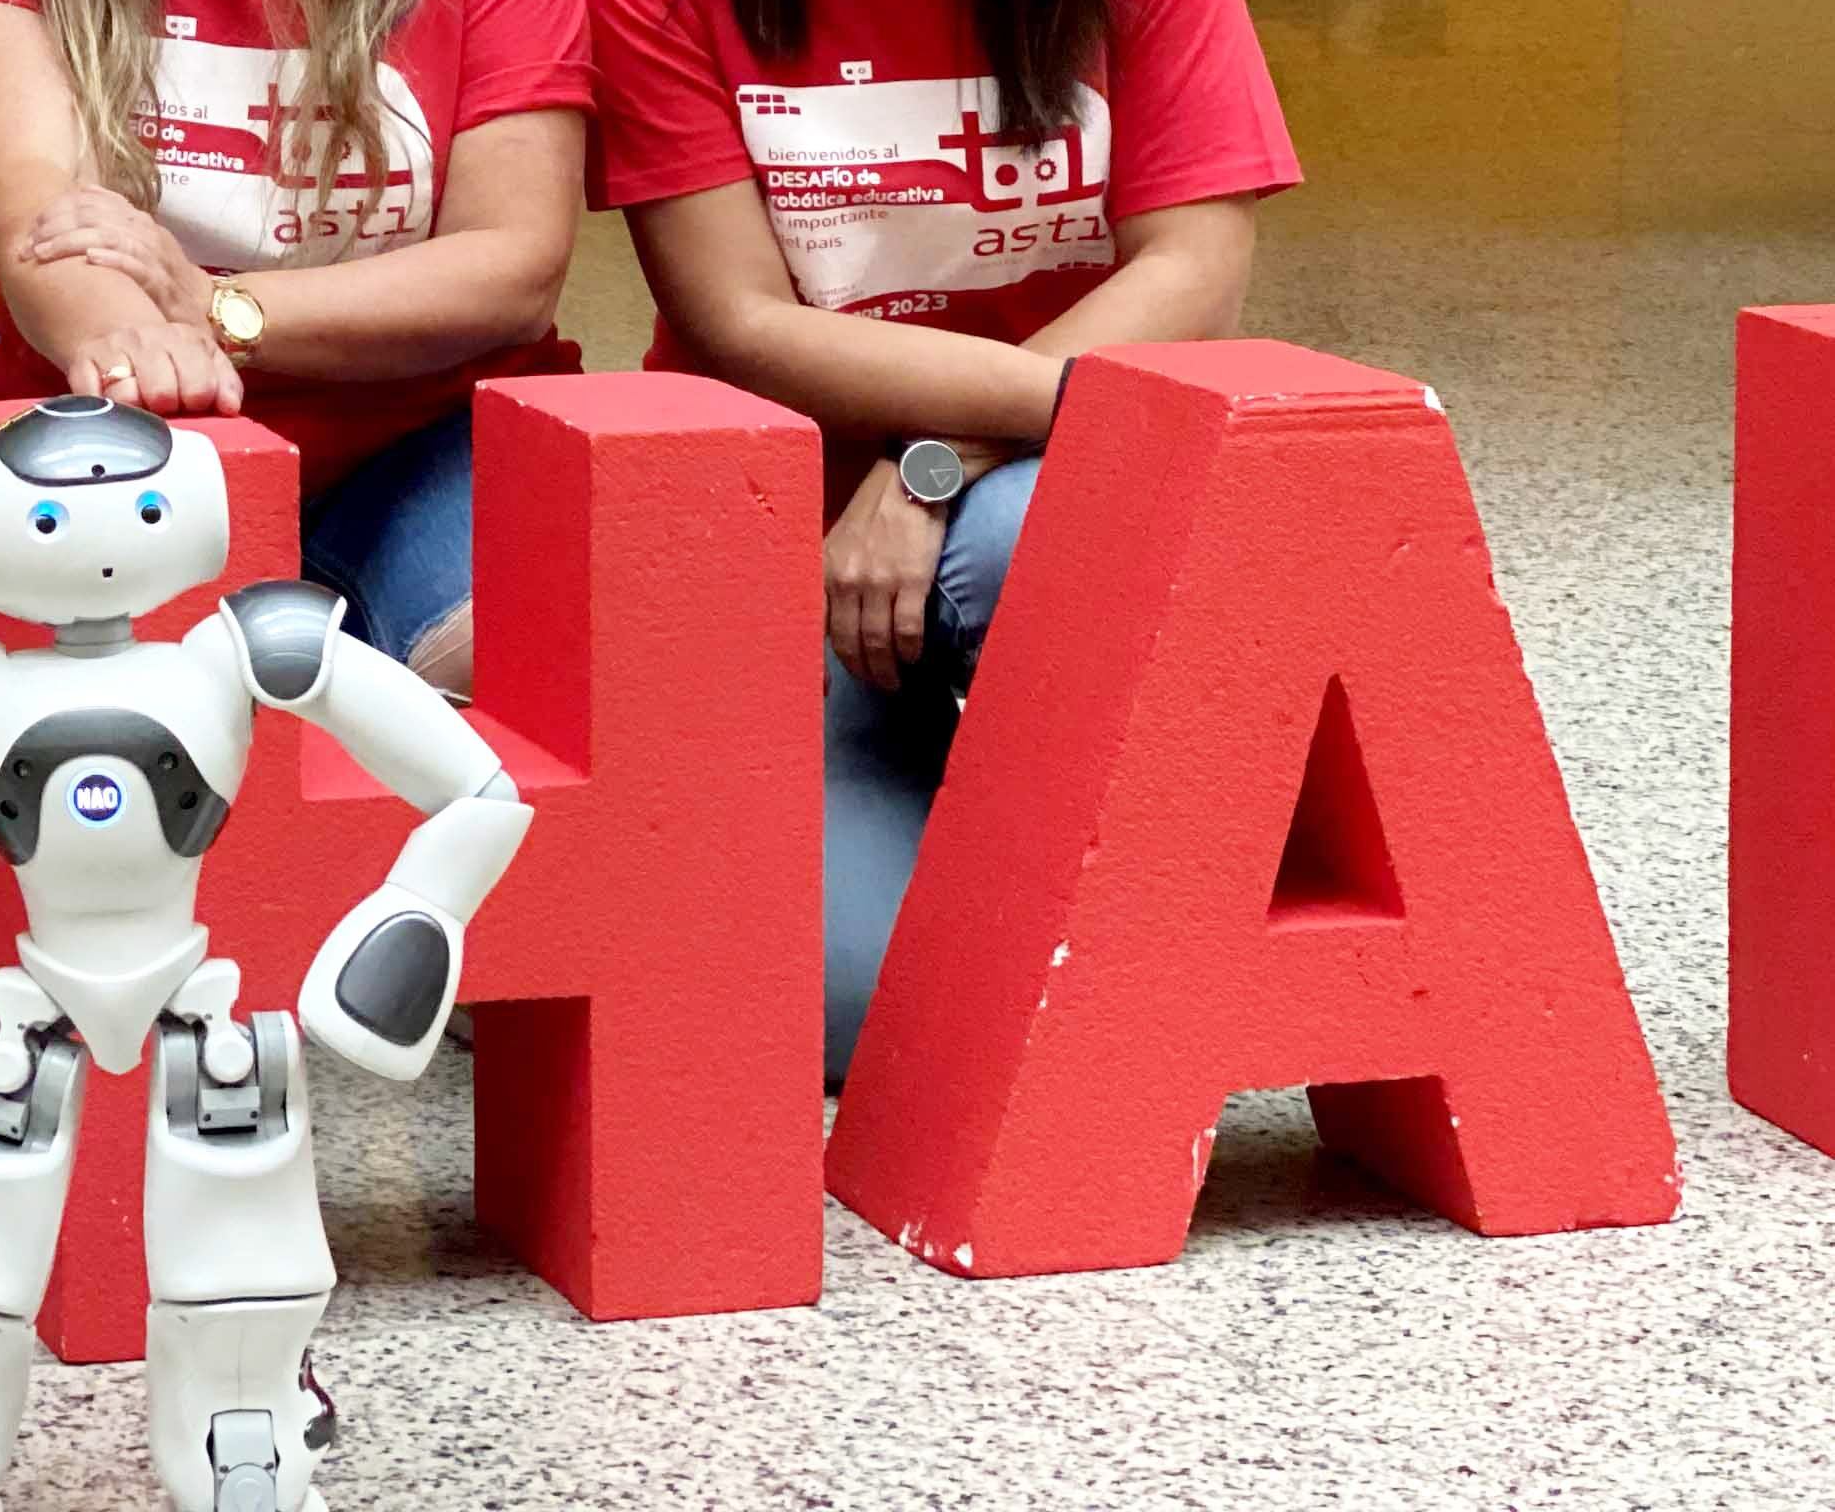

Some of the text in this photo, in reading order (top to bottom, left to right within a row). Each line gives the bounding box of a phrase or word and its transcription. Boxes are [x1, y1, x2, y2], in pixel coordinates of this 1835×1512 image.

[192, 104, 209, 120] al
[160, 123, 186, 143] de
[154, 145, 245, 171] educativa
[768, 143, 900, 162] bienvenidos al
[767, 166, 882, 188] DESAFÍO de
[769, 186, 945, 209] robótica educativa
[787, 207, 889, 232] importante
[973, 212, 1108, 257] asti
[887, 293, 949, 317] 2023
[76, 786, 119, 810] NAO
